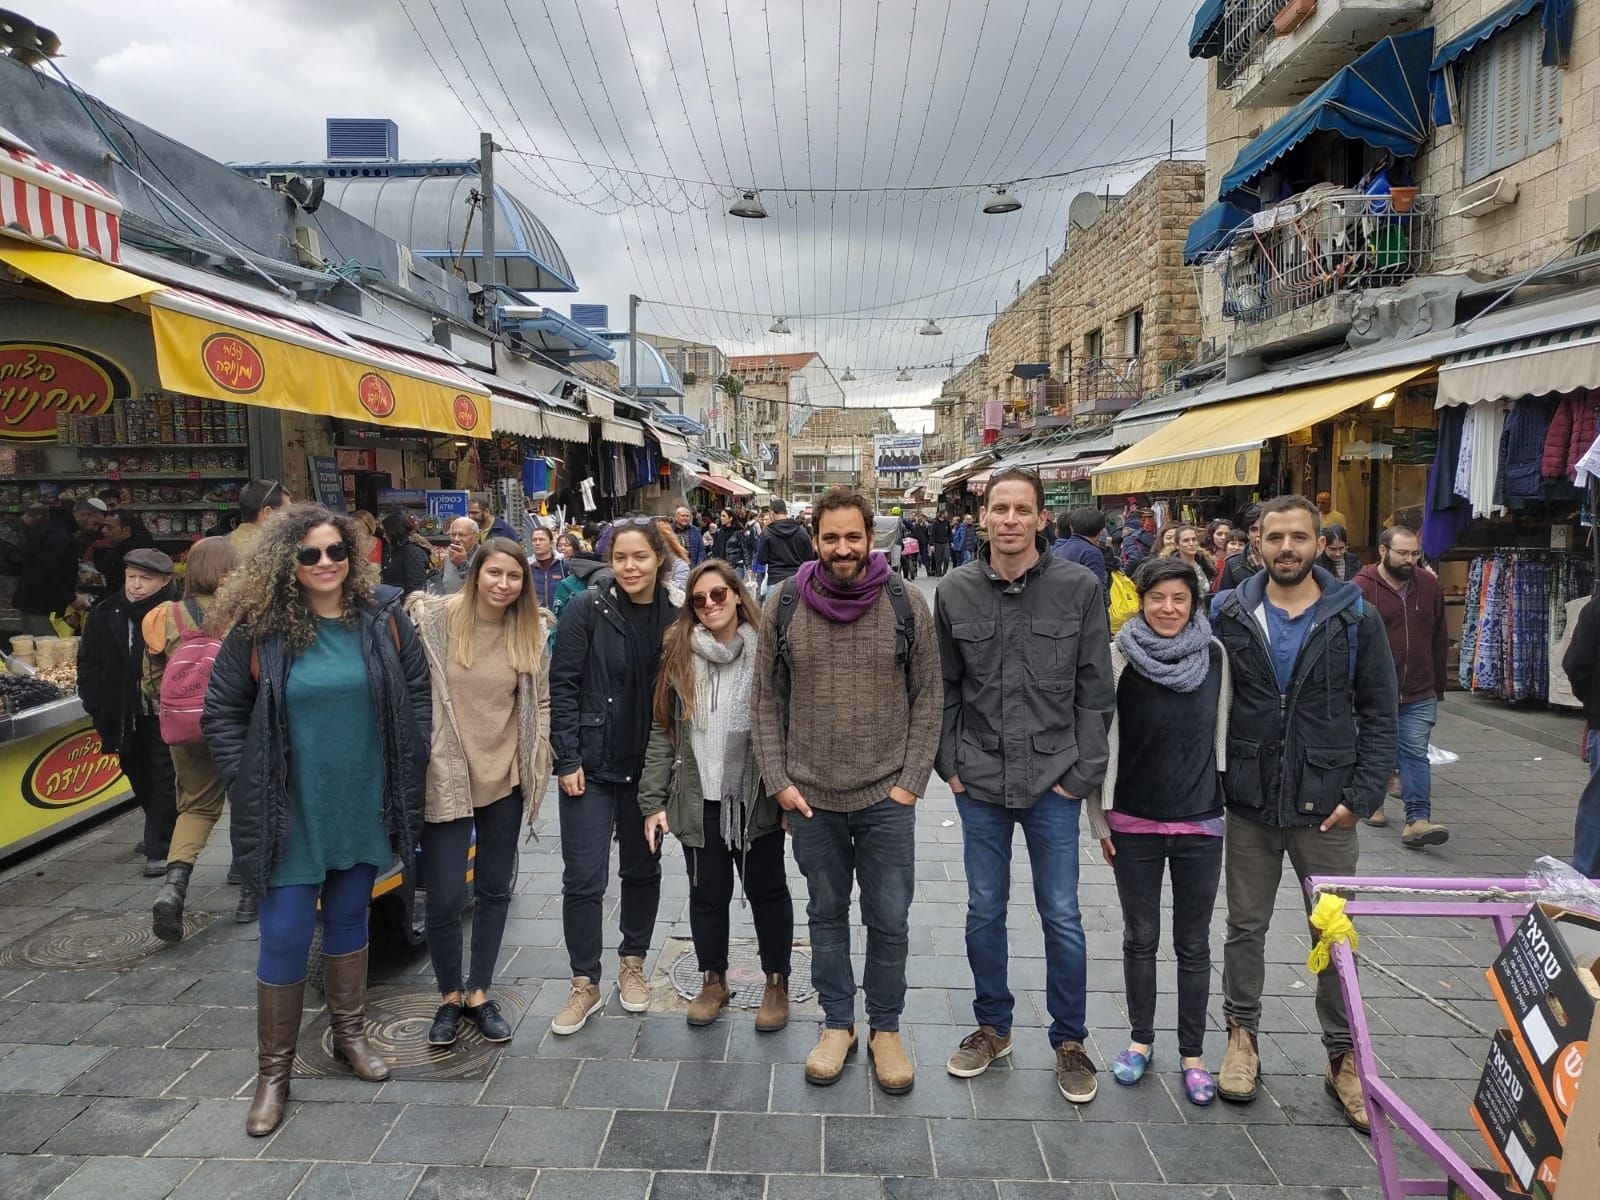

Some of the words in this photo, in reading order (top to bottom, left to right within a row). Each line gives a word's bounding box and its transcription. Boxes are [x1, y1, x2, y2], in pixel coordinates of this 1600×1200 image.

[439, 503, 454, 512] ATM
[67, 736, 102, 762] פיצוחי
[1527, 914, 1561, 979] שמאי
[1493, 1041, 1524, 1102] שמאי
